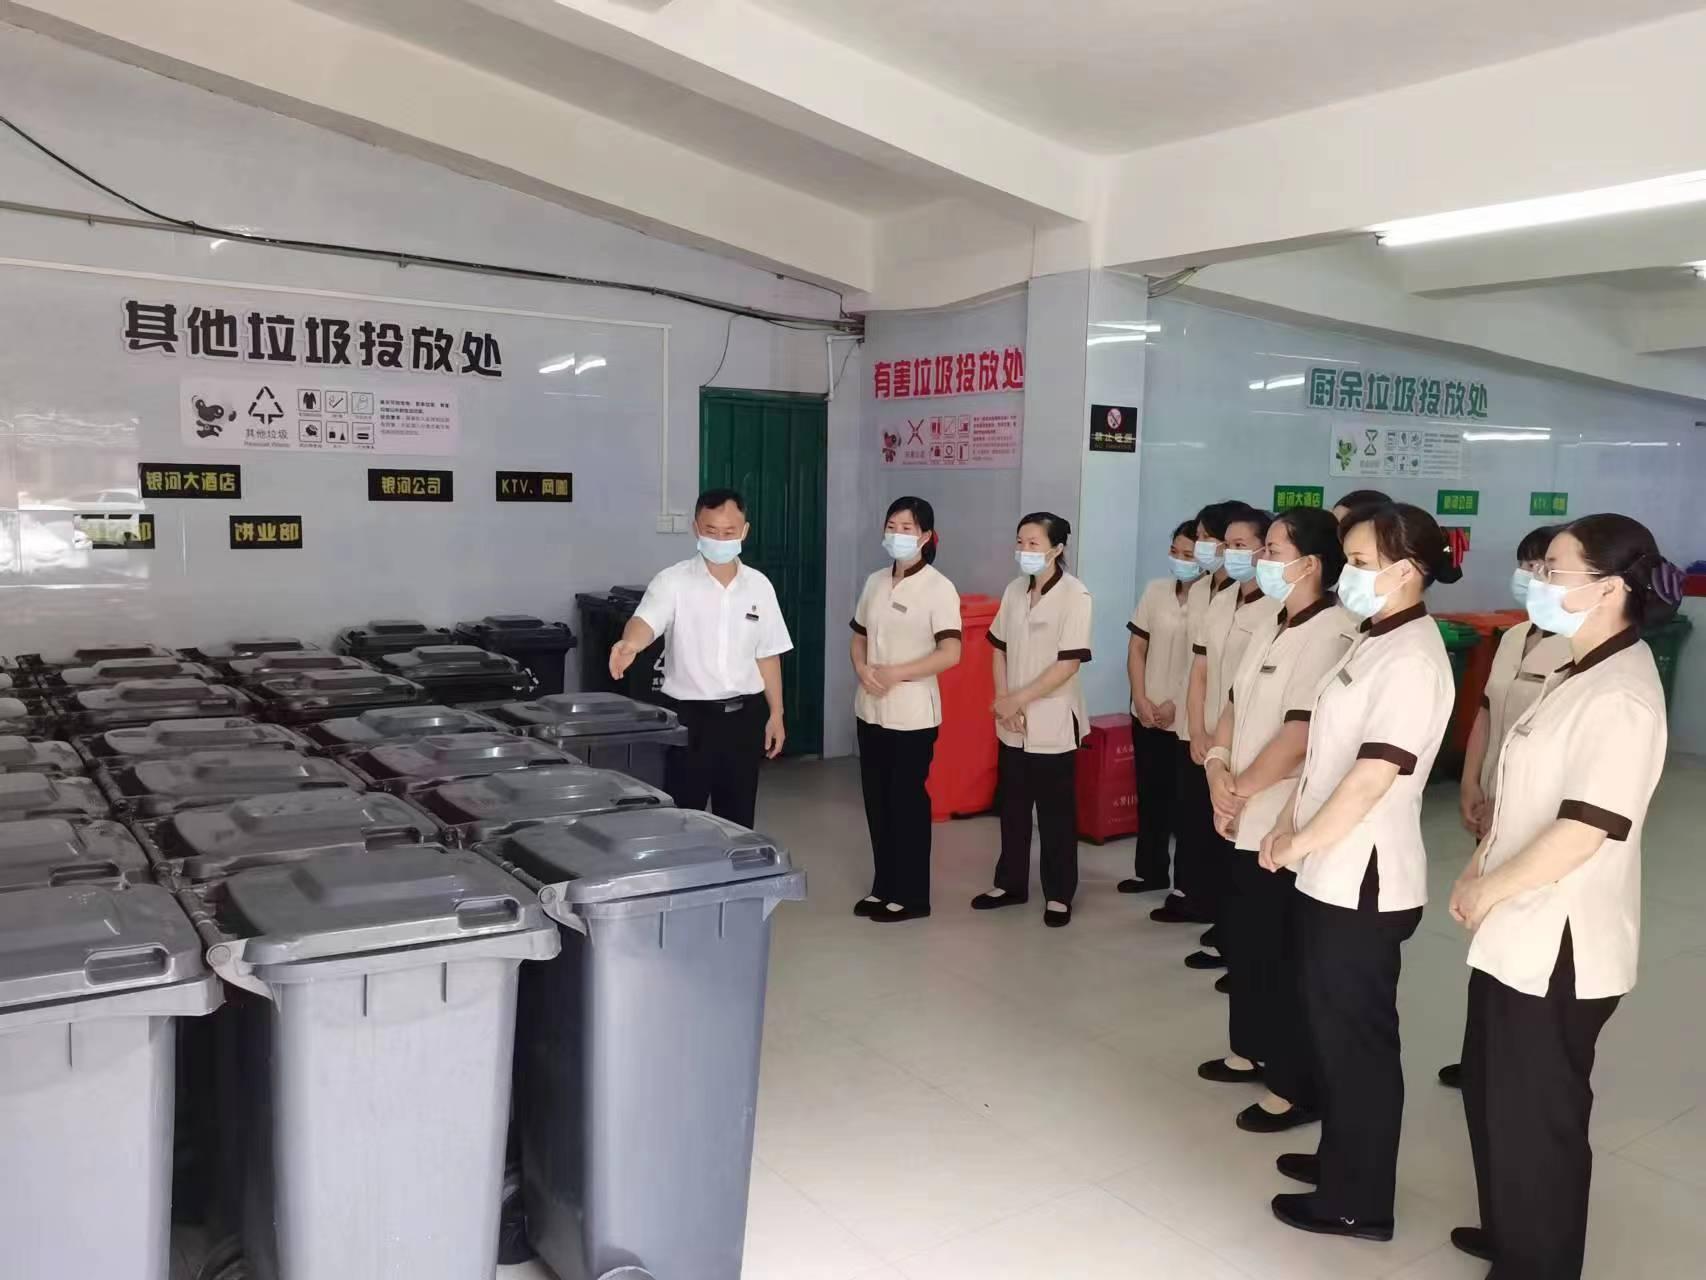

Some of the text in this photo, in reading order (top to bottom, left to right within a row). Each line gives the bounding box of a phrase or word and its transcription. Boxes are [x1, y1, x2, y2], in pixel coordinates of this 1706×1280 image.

[124, 299, 504, 378] 其他垃圾投放处
[874, 346, 1025, 399] 有害垃圾投放处
[1309, 367, 1489, 418] 厨余垃圾投放处
[145, 470, 237, 492] 银河大酒店
[380, 476, 442, 496] 银河公司
[234, 522, 299, 542] 饼业部
